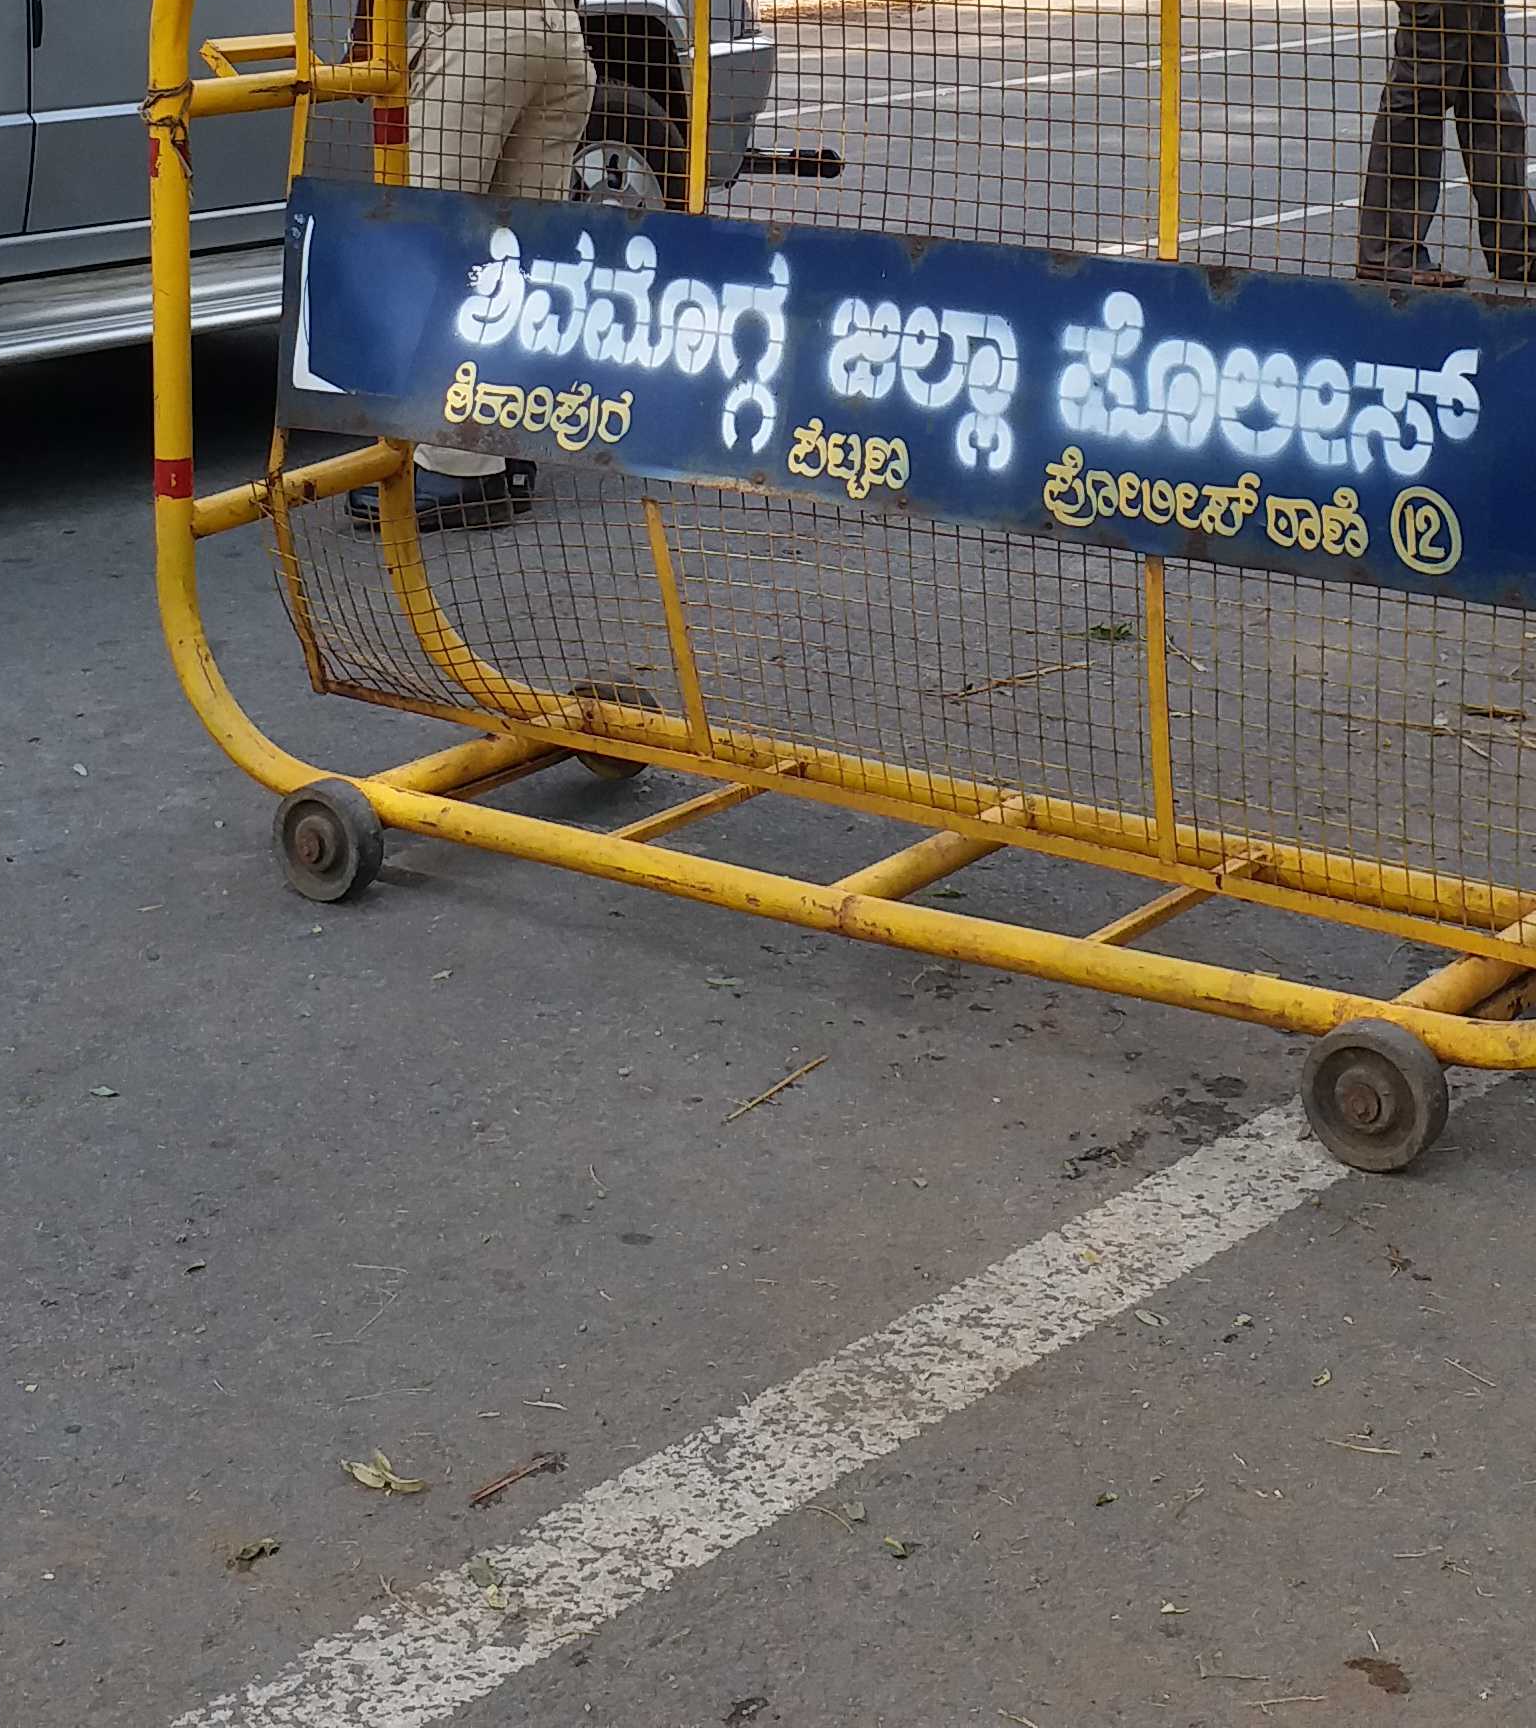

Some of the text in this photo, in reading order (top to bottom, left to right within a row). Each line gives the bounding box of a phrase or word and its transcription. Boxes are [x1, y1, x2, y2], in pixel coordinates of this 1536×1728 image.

[444, 360, 635, 452] ಶಿಕಾರಿಪುರ
[457, 226, 790, 454] ಶಿವಮೊಗ್ಗ
[828, 297, 1019, 470] ಜಿಲ್ಲಾ
